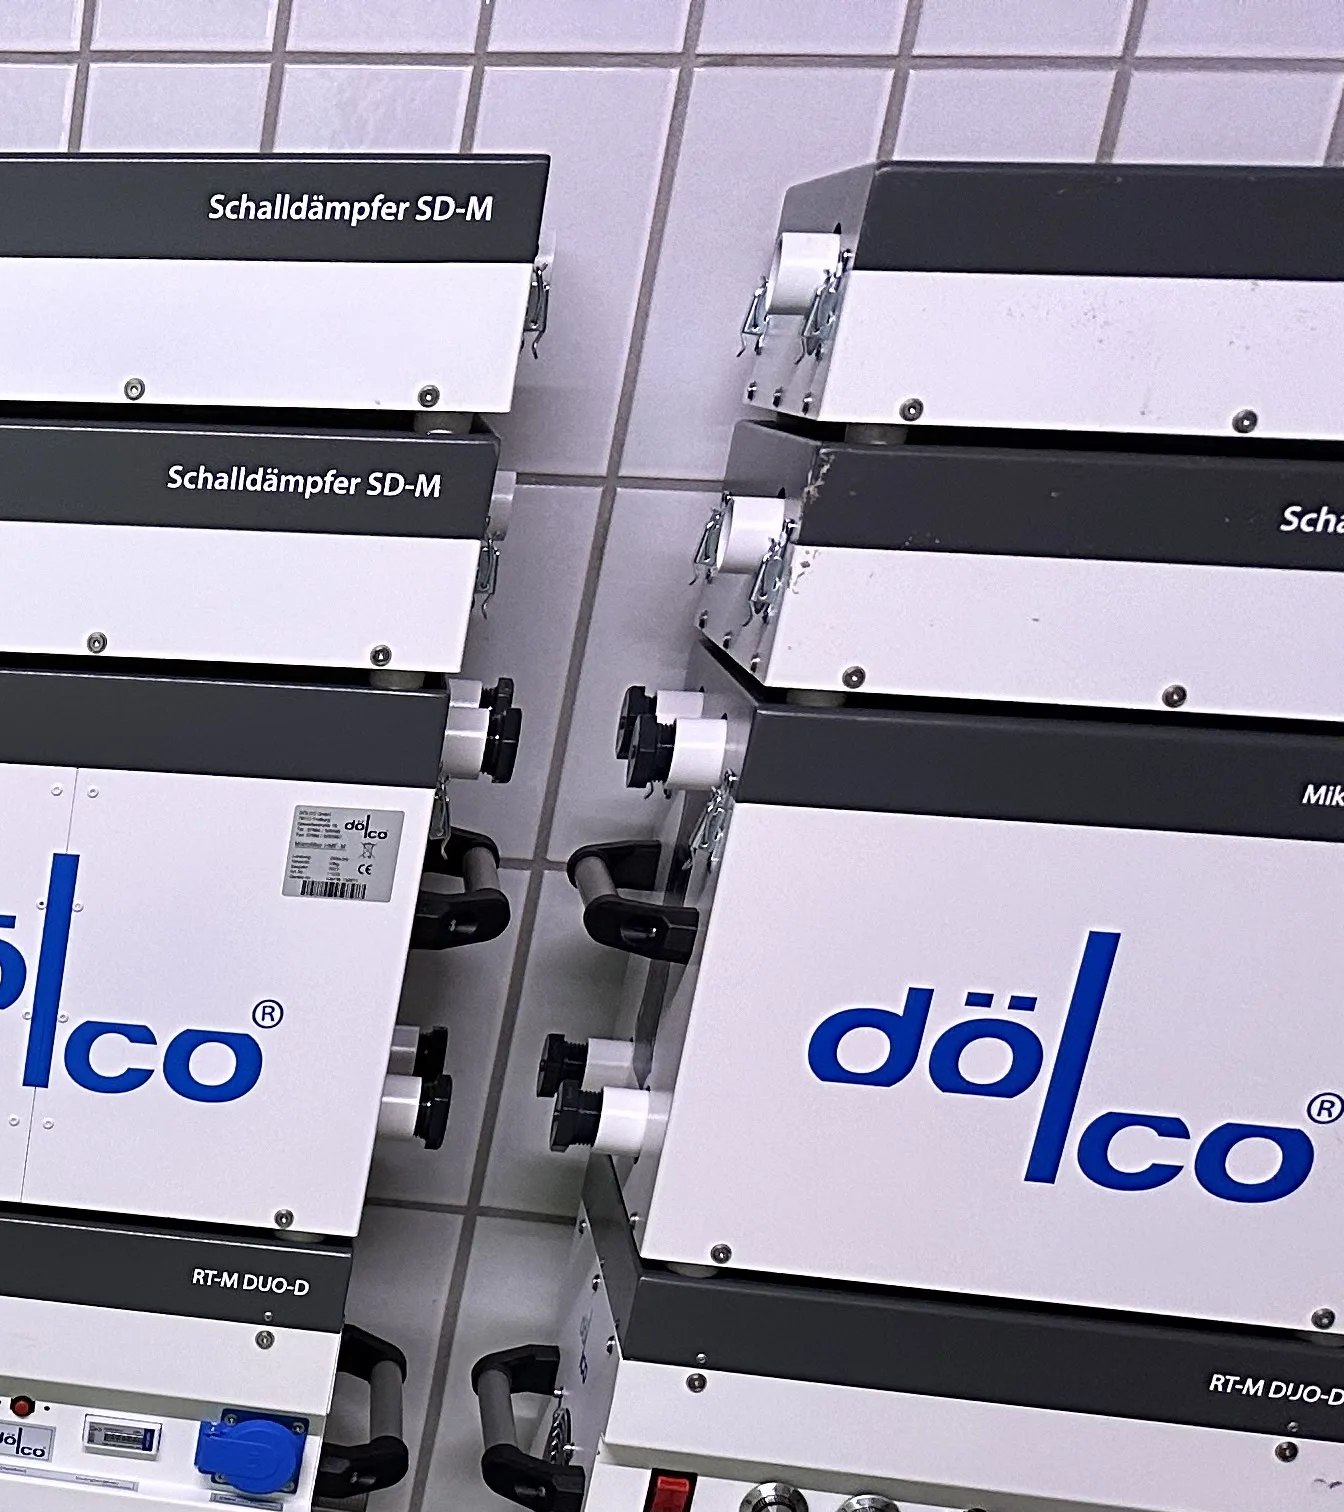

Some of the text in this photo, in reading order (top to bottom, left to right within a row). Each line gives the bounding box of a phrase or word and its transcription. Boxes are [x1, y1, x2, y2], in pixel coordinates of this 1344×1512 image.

[209, 194, 493, 226] Schalldämpfer SD-M
[167, 466, 440, 499] Schalldämpfer SD-M
[344, 814, 388, 839] dölco
[808, 931, 1314, 1203] dölco
[193, 1269, 309, 1295] RT-M DUO-D
[1210, 1374, 1344, 1405] RT-M DUO-D
